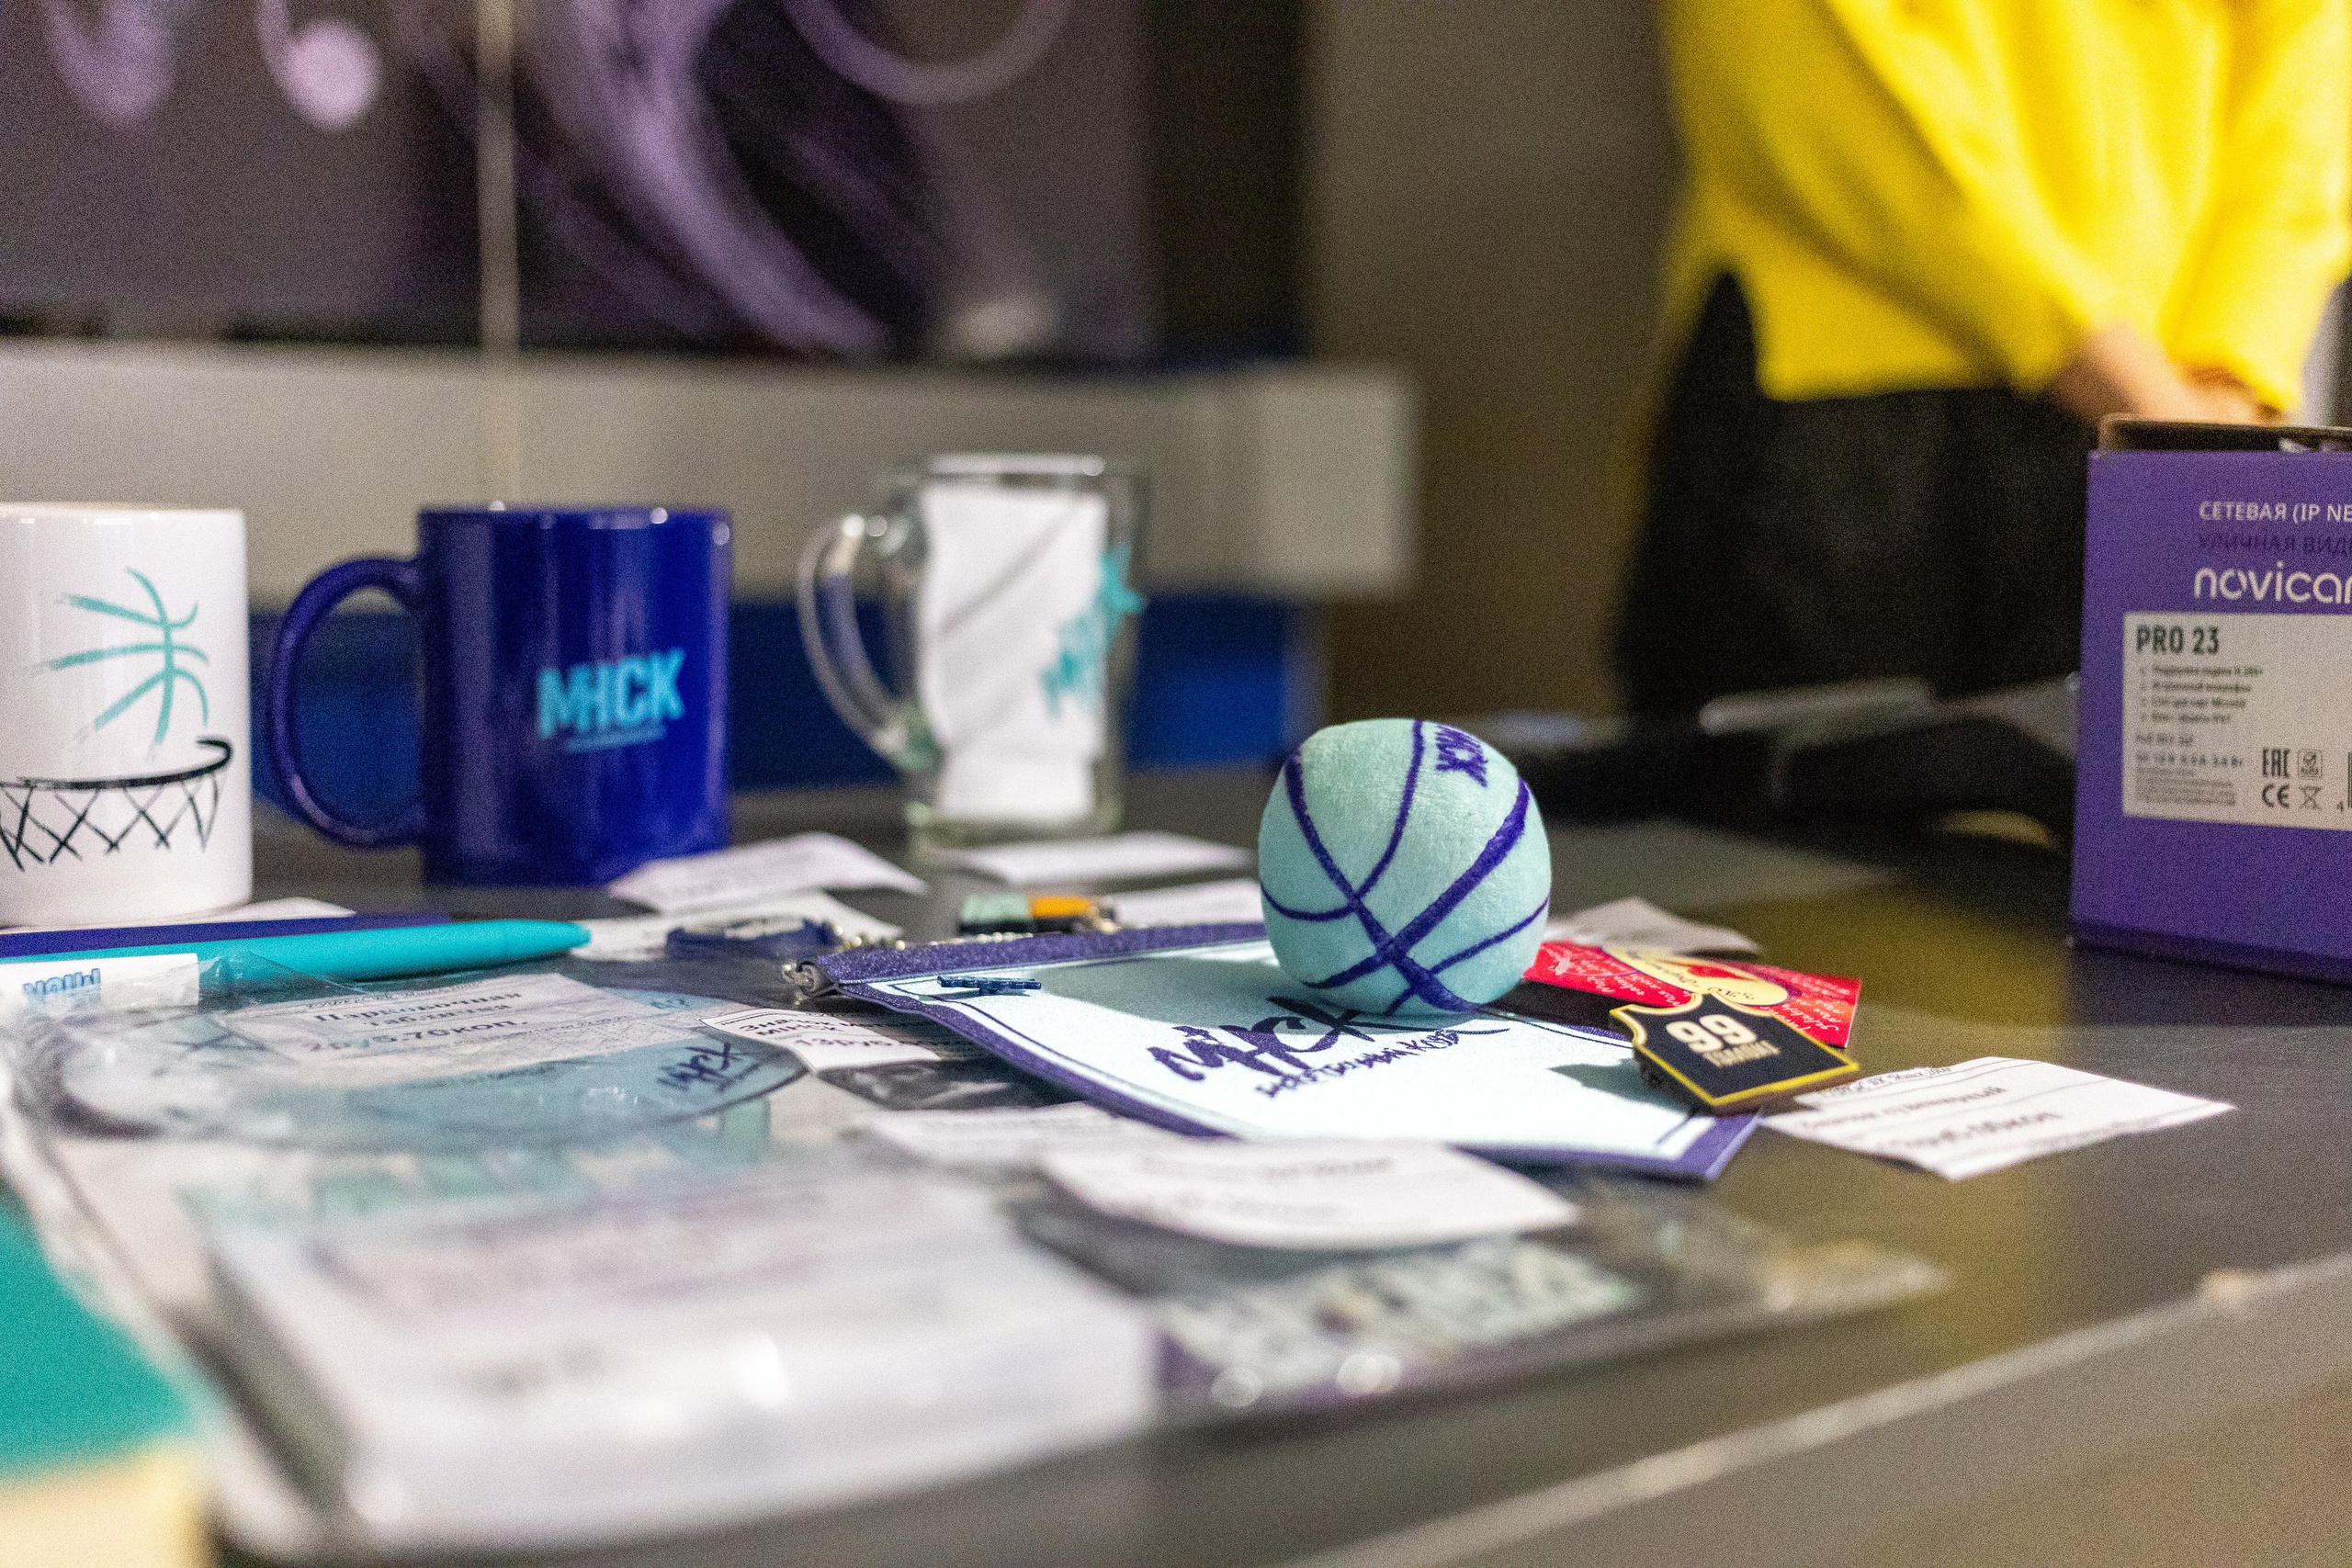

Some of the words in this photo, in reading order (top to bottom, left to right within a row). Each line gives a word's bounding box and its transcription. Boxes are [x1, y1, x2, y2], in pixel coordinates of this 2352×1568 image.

[2199, 501, 2287, 522] СЕТЕВАЯ
[2293, 502, 2320, 525] (IP
[2136, 625, 2184, 654] PRO
[2193, 626, 2220, 655] 23
[1666, 1014, 1757, 1054] 99
